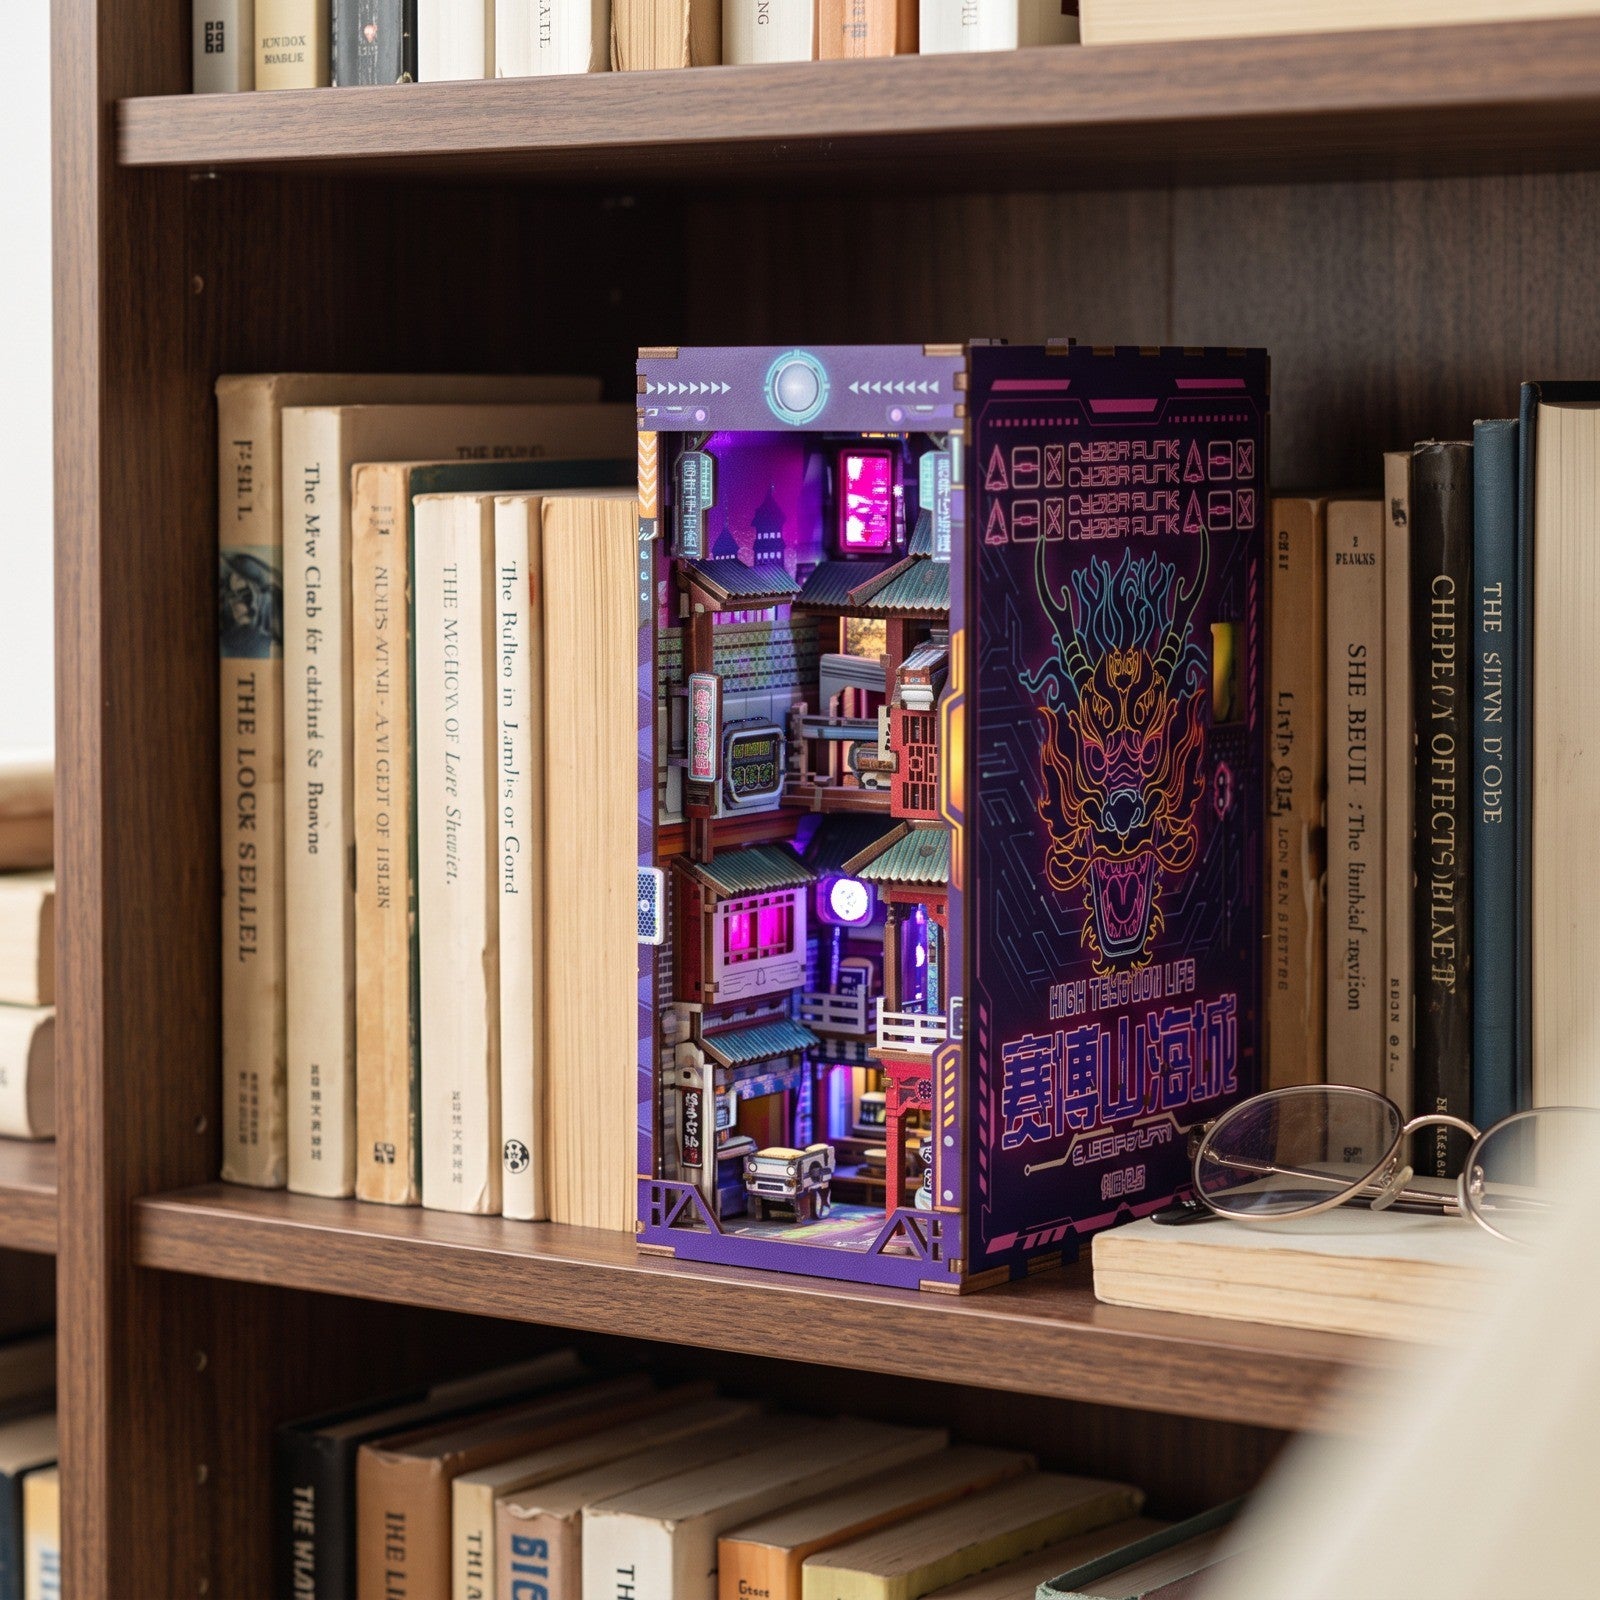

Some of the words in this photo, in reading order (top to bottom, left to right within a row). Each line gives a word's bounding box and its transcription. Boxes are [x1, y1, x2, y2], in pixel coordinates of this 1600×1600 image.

[305, 463, 321, 504] The
[443, 563, 458, 608] THE
[502, 561, 518, 601] The
[1483, 582, 1502, 633] THE
[1348, 643, 1366, 697] SHE
[237, 672, 257, 735] THE
[503, 687, 516, 707] in
[445, 719, 460, 743] OF
[377, 812, 390, 838] OF
[503, 806, 516, 828] or
[1348, 814, 1365, 851] The
[293, 1486, 315, 1536] THE
